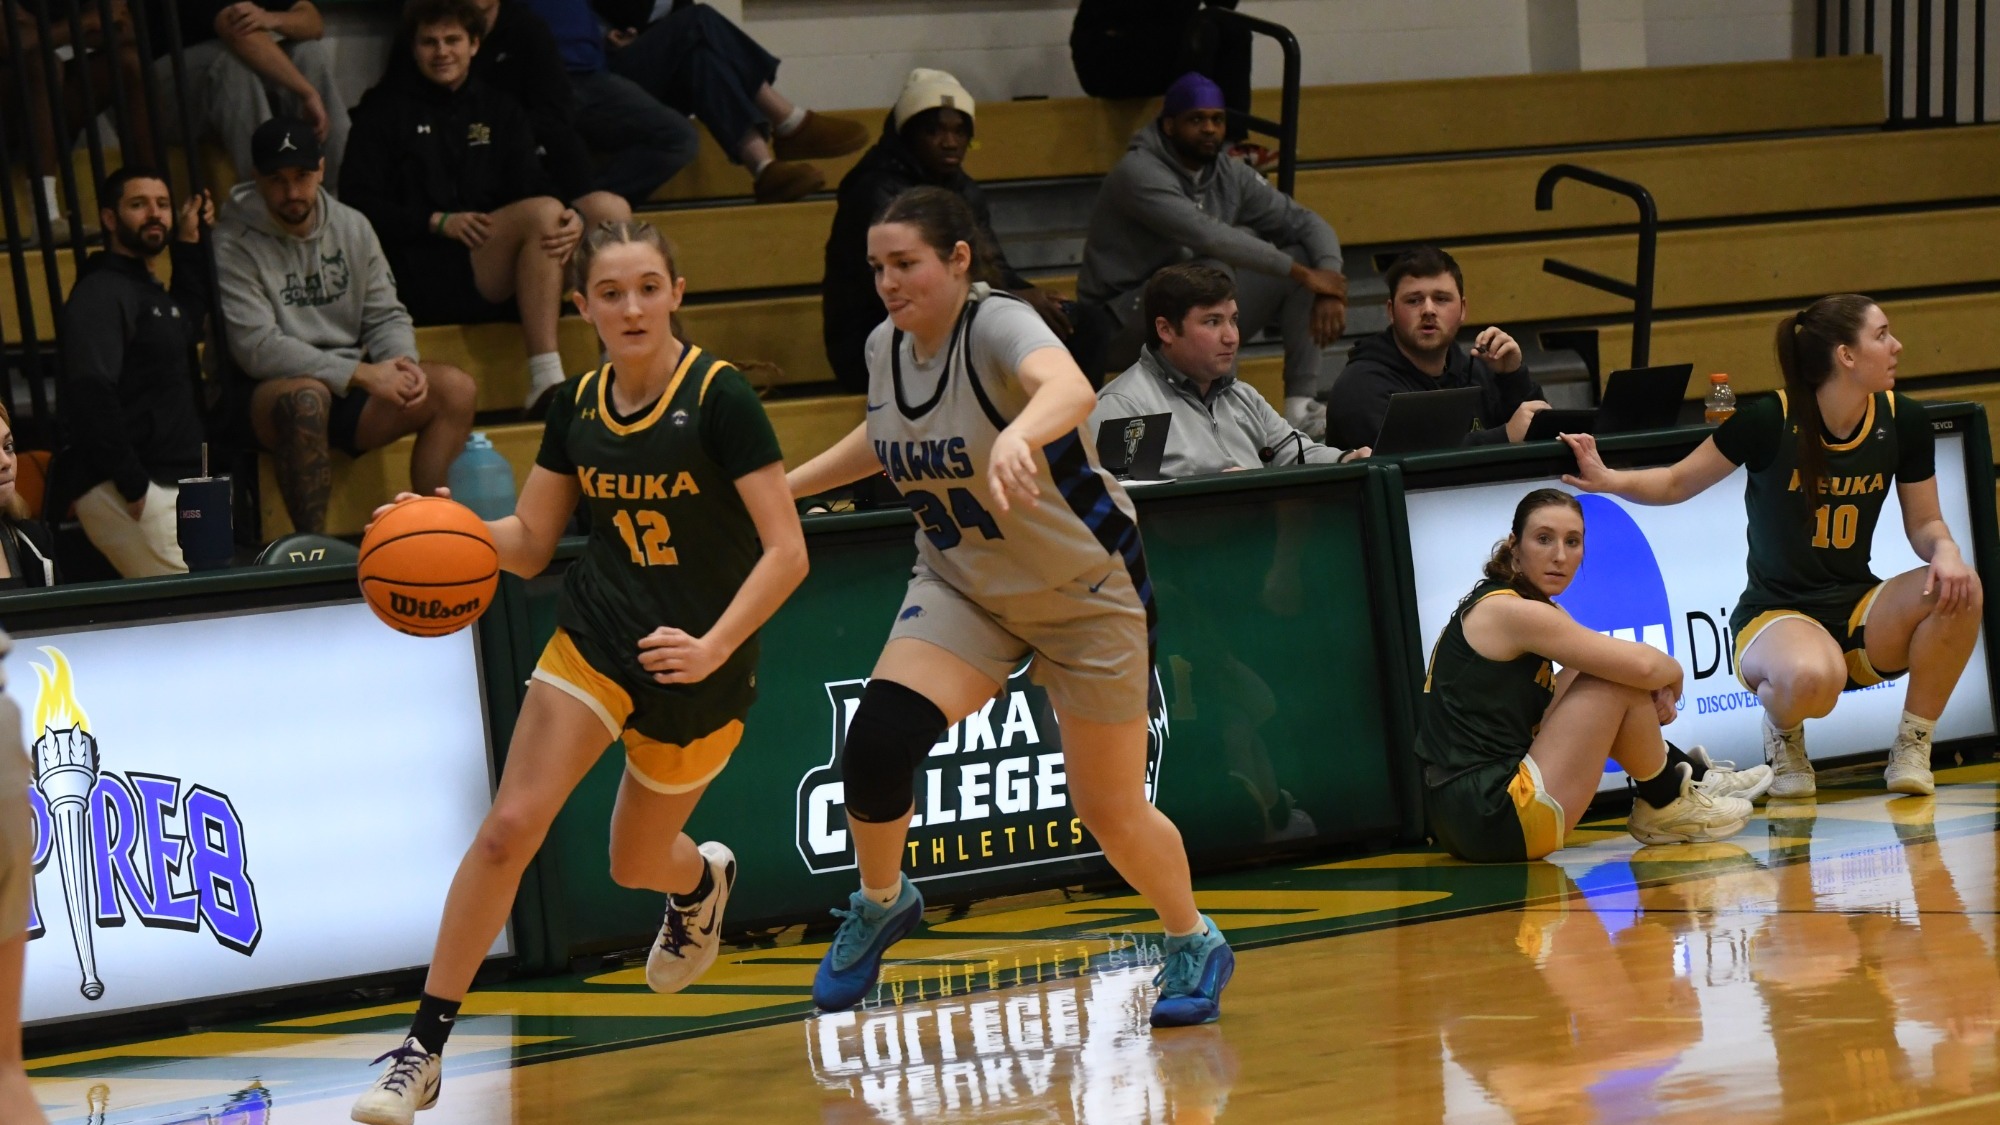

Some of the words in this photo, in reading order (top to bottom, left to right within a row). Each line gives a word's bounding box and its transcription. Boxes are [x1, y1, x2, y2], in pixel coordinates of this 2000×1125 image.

[577, 465, 700, 499] KEUKA
[874, 437, 974, 482] HAWKS
[612, 510, 679, 567] 12
[904, 488, 1005, 550] 34
[1812, 504, 1858, 549] 10
[390, 591, 480, 619] Wilson
[808, 752, 1067, 855] CLEGE
[27, 770, 262, 957] PIRE8
[907, 817, 1083, 868] THLETICS
